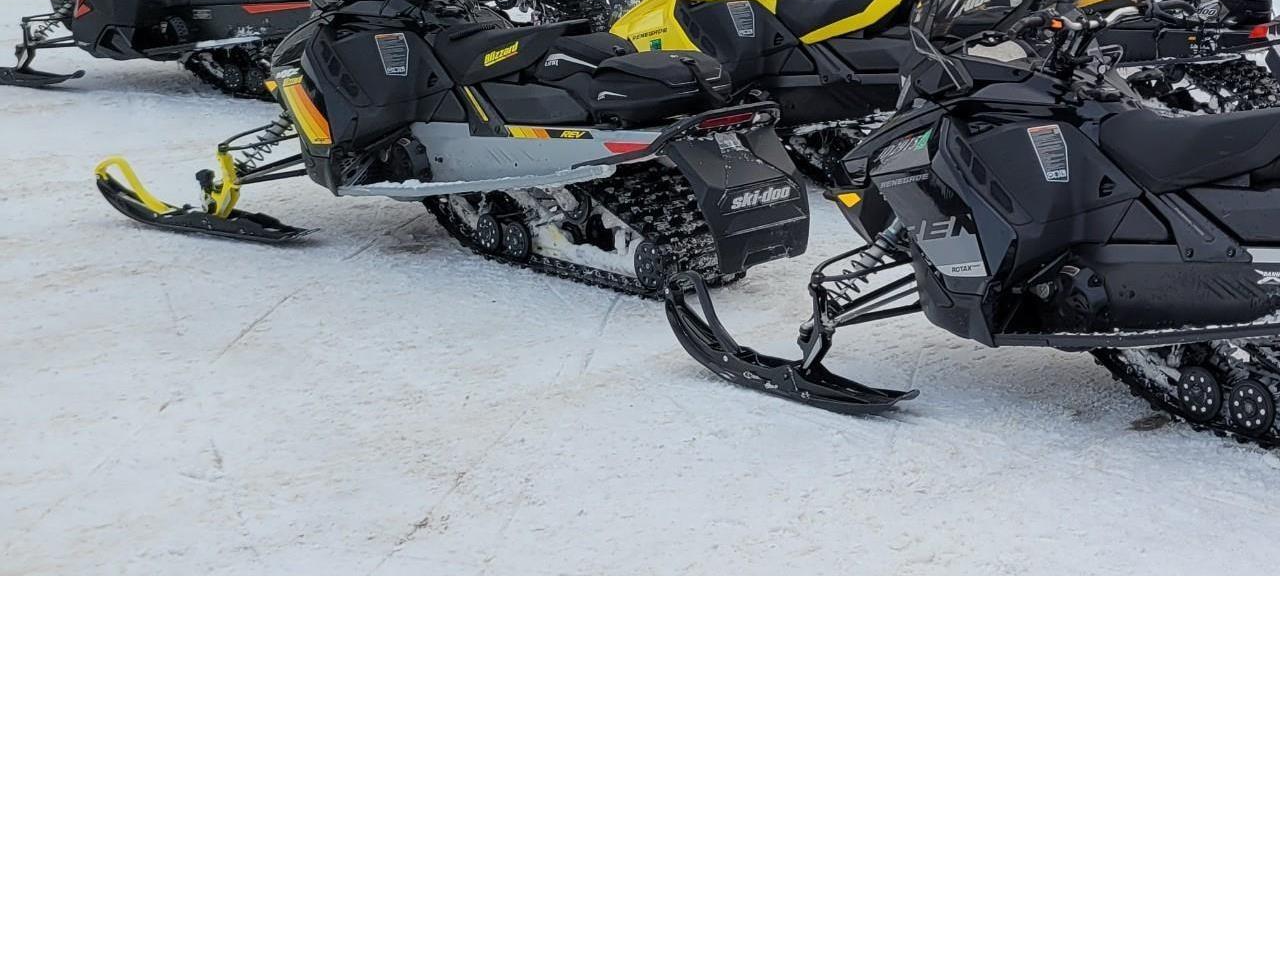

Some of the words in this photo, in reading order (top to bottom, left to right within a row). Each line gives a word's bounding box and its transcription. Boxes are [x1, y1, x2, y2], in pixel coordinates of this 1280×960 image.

[560, 130, 586, 138] REV
[880, 173, 929, 189] RENEGADE
[731, 186, 791, 210] ski-doo
[951, 265, 972, 273] ROTAX
